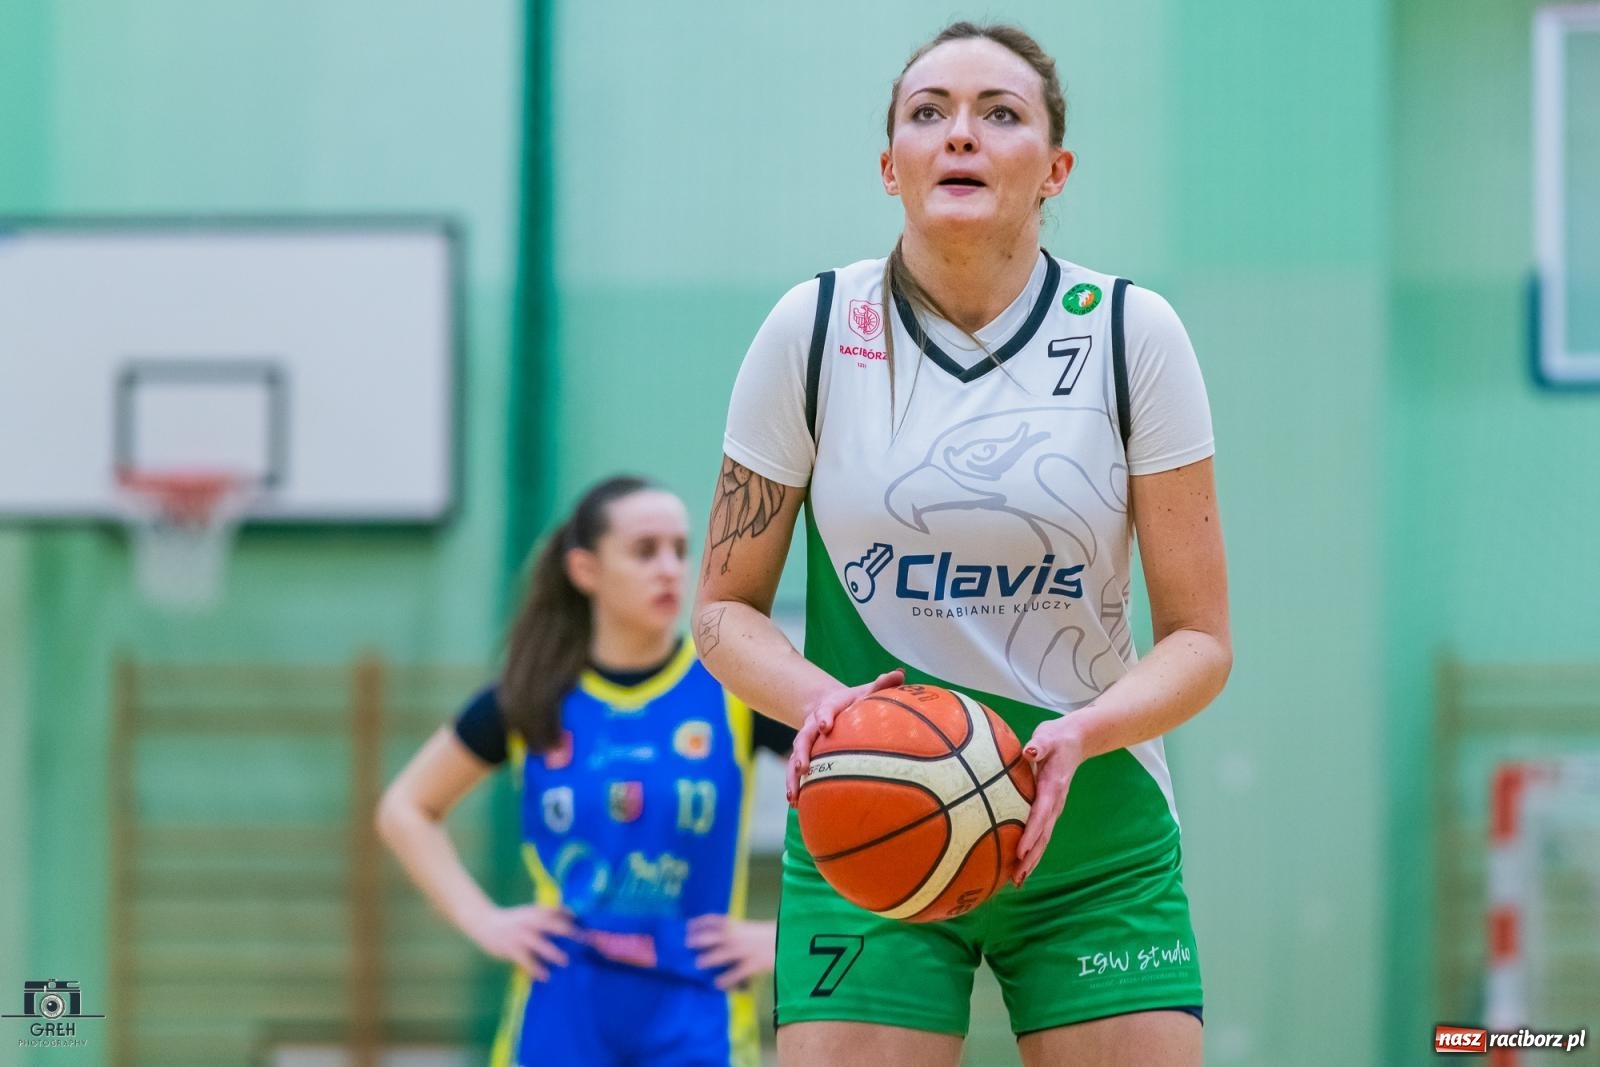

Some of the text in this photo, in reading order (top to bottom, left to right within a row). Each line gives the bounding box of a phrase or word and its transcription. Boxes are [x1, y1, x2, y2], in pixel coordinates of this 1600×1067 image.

[1048, 335, 1092, 395] 7
[896, 552, 1085, 600] Clavis
[912, 600, 1072, 618] DORABIANIE KLUCZY
[809, 933, 865, 998] 7
